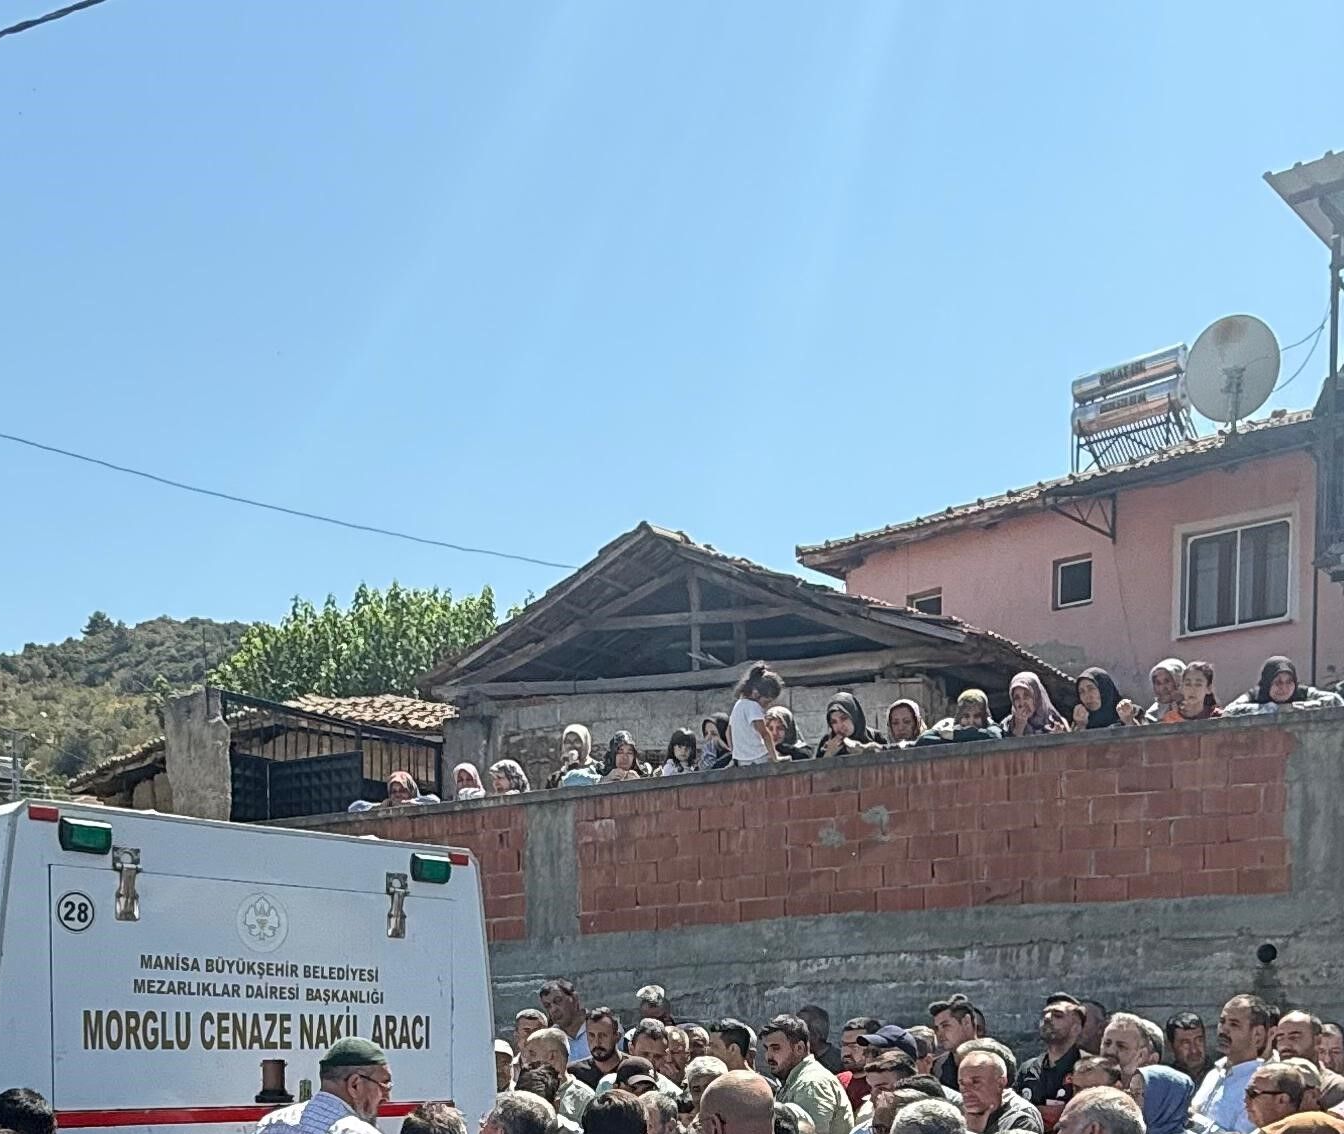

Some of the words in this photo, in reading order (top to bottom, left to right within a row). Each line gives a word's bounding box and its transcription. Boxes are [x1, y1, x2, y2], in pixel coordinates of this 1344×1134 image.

[63, 901, 88, 923] 28
[140, 953, 201, 973] MANİSA
[205, 956, 299, 980] BÜYÜKŞEHİR
[303, 963, 379, 983] BELEDİYESİ
[133, 978, 241, 998] MEZARLIKLAR
[245, 982, 300, 1000] DAİRESİ
[305, 987, 384, 1006] BAŞKANLIĞI
[83, 1010, 192, 1050] MORGLU
[200, 1011, 292, 1050] CENAZE
[371, 1014, 430, 1050] ARACI
